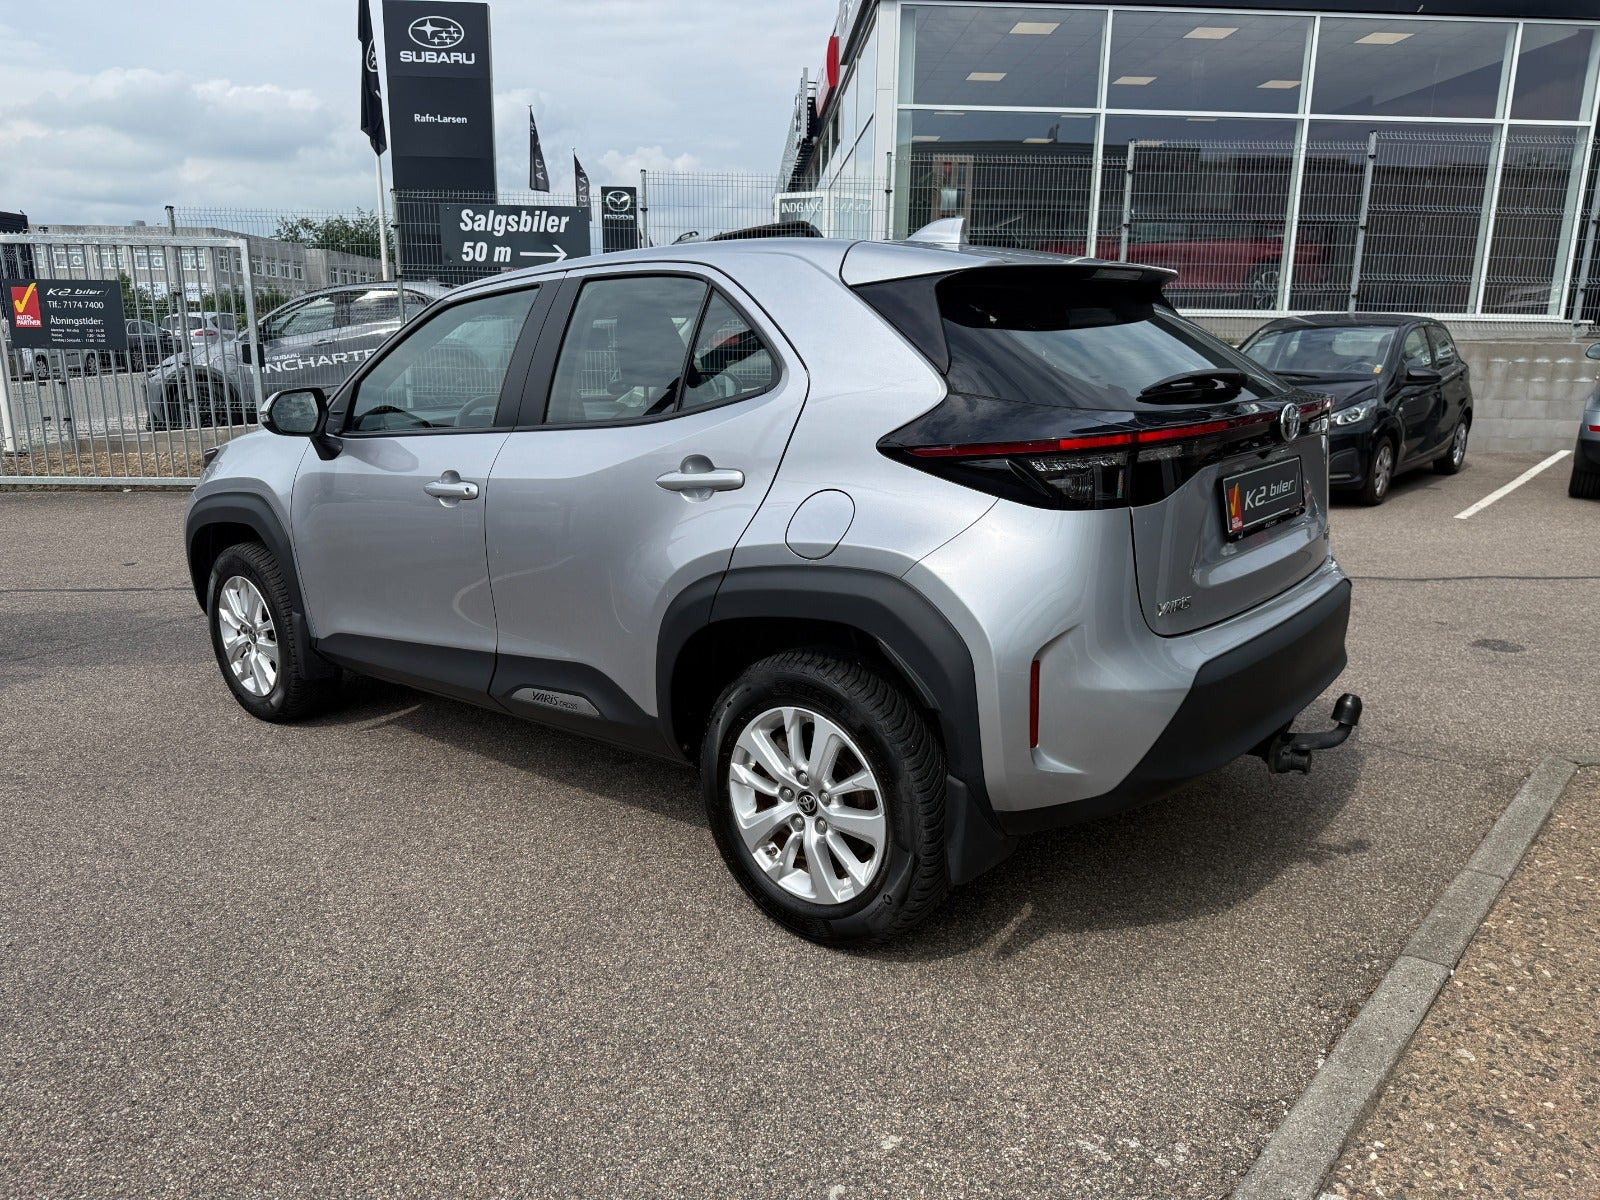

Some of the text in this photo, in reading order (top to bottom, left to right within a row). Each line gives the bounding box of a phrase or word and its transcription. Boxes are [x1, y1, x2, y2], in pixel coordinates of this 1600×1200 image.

[399, 50, 476, 65] SUBARU
[413, 113, 468, 124] Rafn-Larsen
[781, 201, 822, 214] INDGANG
[459, 208, 570, 237] Salgsbiler
[461, 241, 512, 263] 50 m
[46, 288, 71, 296] K2
[63, 300, 82, 309] 7174
[85, 301, 104, 309] 7400
[50, 315, 104, 326] Åbningstider:
[272, 352, 301, 360] SUBARU
[1245, 479, 1295, 511] K2 biler
